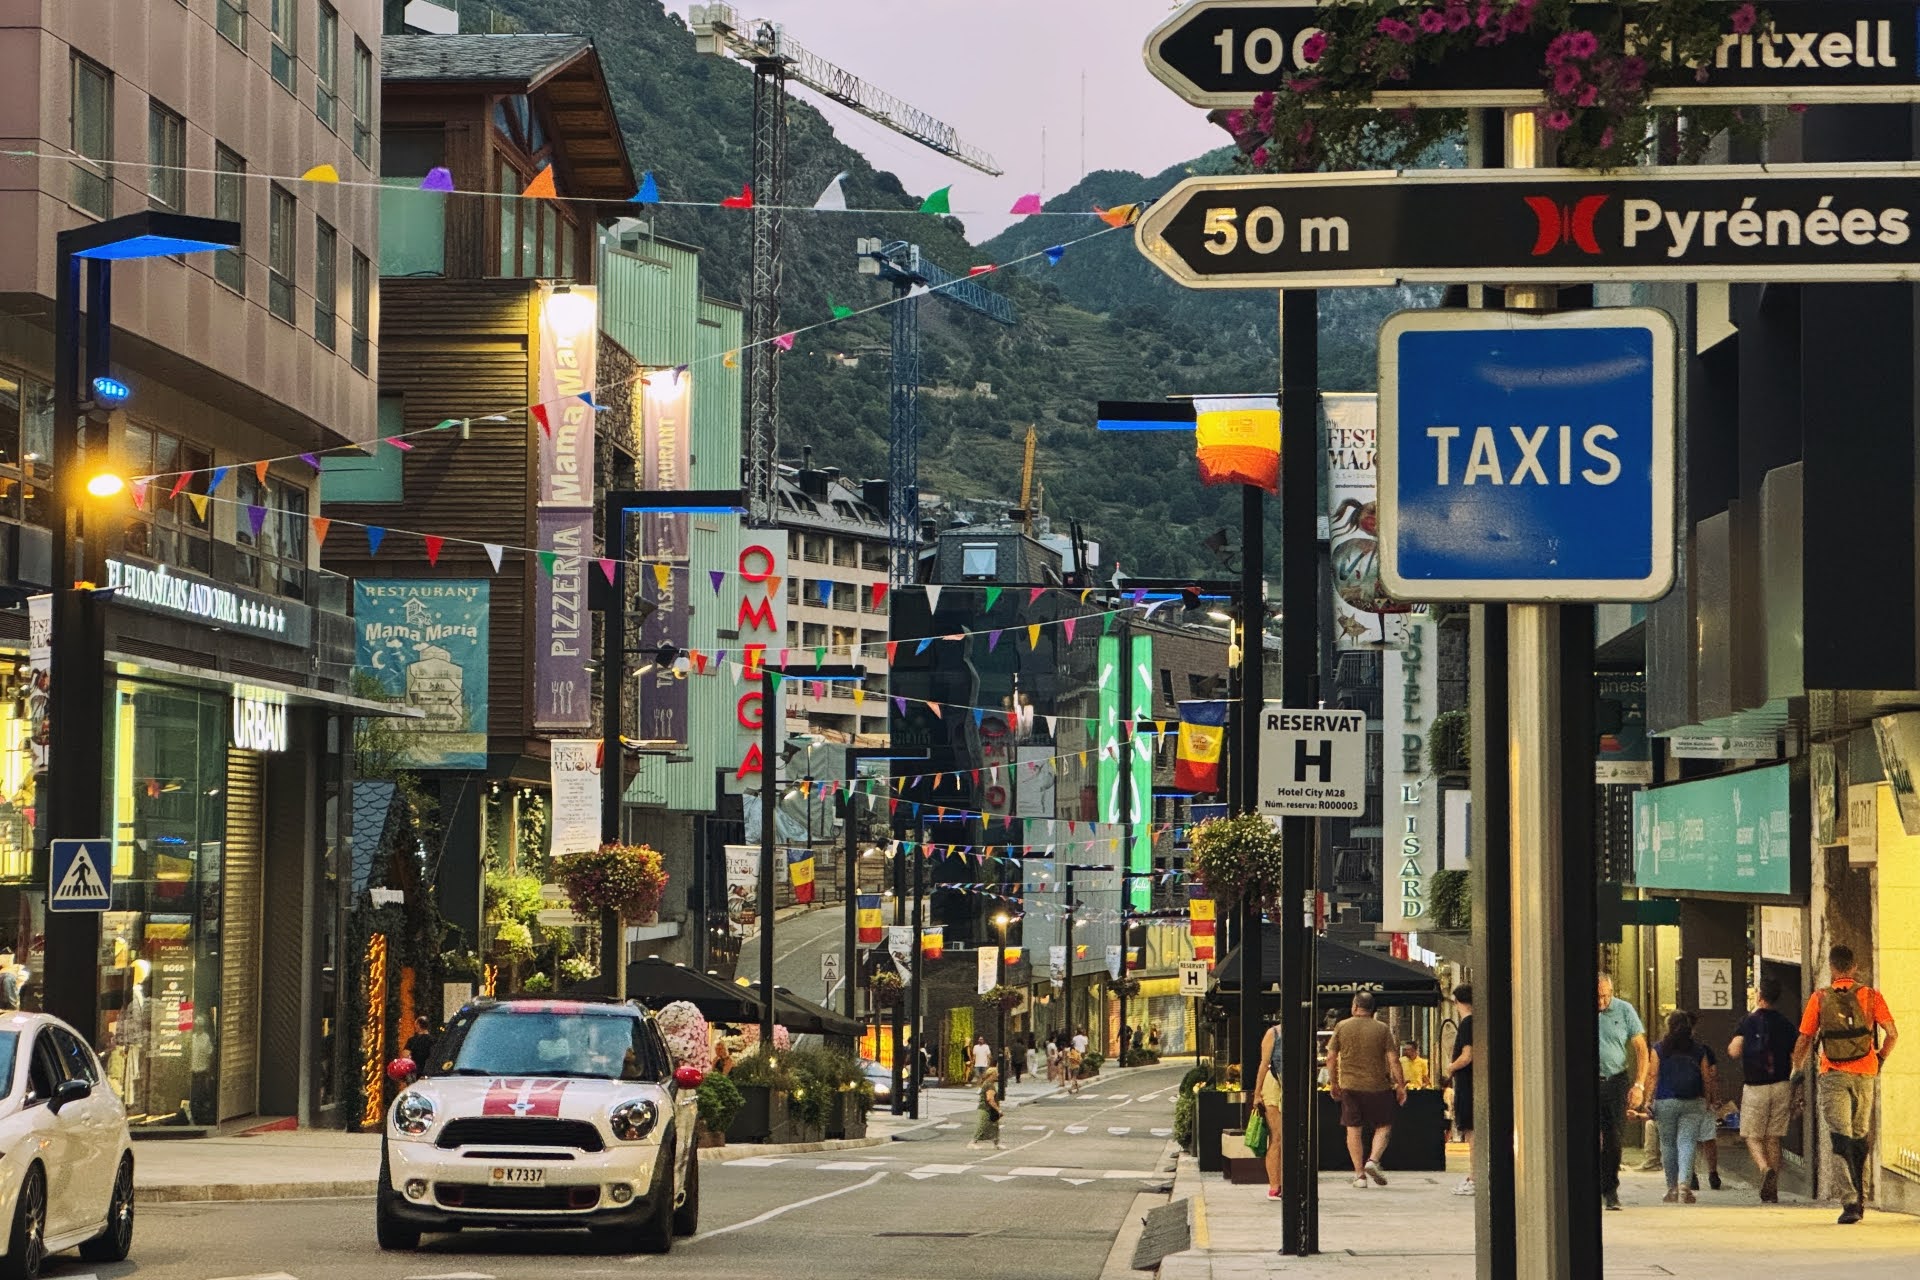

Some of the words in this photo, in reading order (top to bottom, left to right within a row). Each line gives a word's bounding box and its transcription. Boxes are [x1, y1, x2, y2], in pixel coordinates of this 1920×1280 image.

[1203, 205, 1286, 257] 50
[1300, 215, 1350, 254] m
[1623, 195, 1911, 258] Pyrénées
[554, 336, 586, 397] Mar
[1326, 428, 1377, 449] FEST
[551, 405, 585, 502] Mama
[1426, 423, 1622, 486] TAXIS
[123, 564, 189, 612] EUROSTARS
[187, 582, 239, 624] ANDORRA
[365, 586, 479, 597] RESTAURANT
[550, 525, 582, 657] PIZZERIA
[365, 622, 421, 642] Mama
[425, 623, 478, 642] Maria
[735, 544, 778, 780] OMEGA
[233, 697, 287, 752] URBAN
[1266, 714, 1363, 733] RESERVAT
[554, 751, 585, 761] FESTA
[1293, 739, 1332, 783] H
[1401, 733, 1423, 773] DE
[1277, 787, 1303, 797] Hotel
[1304, 788, 1324, 799] City
[1325, 788, 1346, 798] M28
[1264, 800, 1285, 808] Núm.
[1286, 801, 1318, 809] reserva:
[1318, 800, 1359, 811] R000003
[1187, 971, 1198, 986] H
[1712, 969, 1729, 985] A
[1712, 990, 1728, 1007] B
[516, 1168, 543, 1182] 7337
